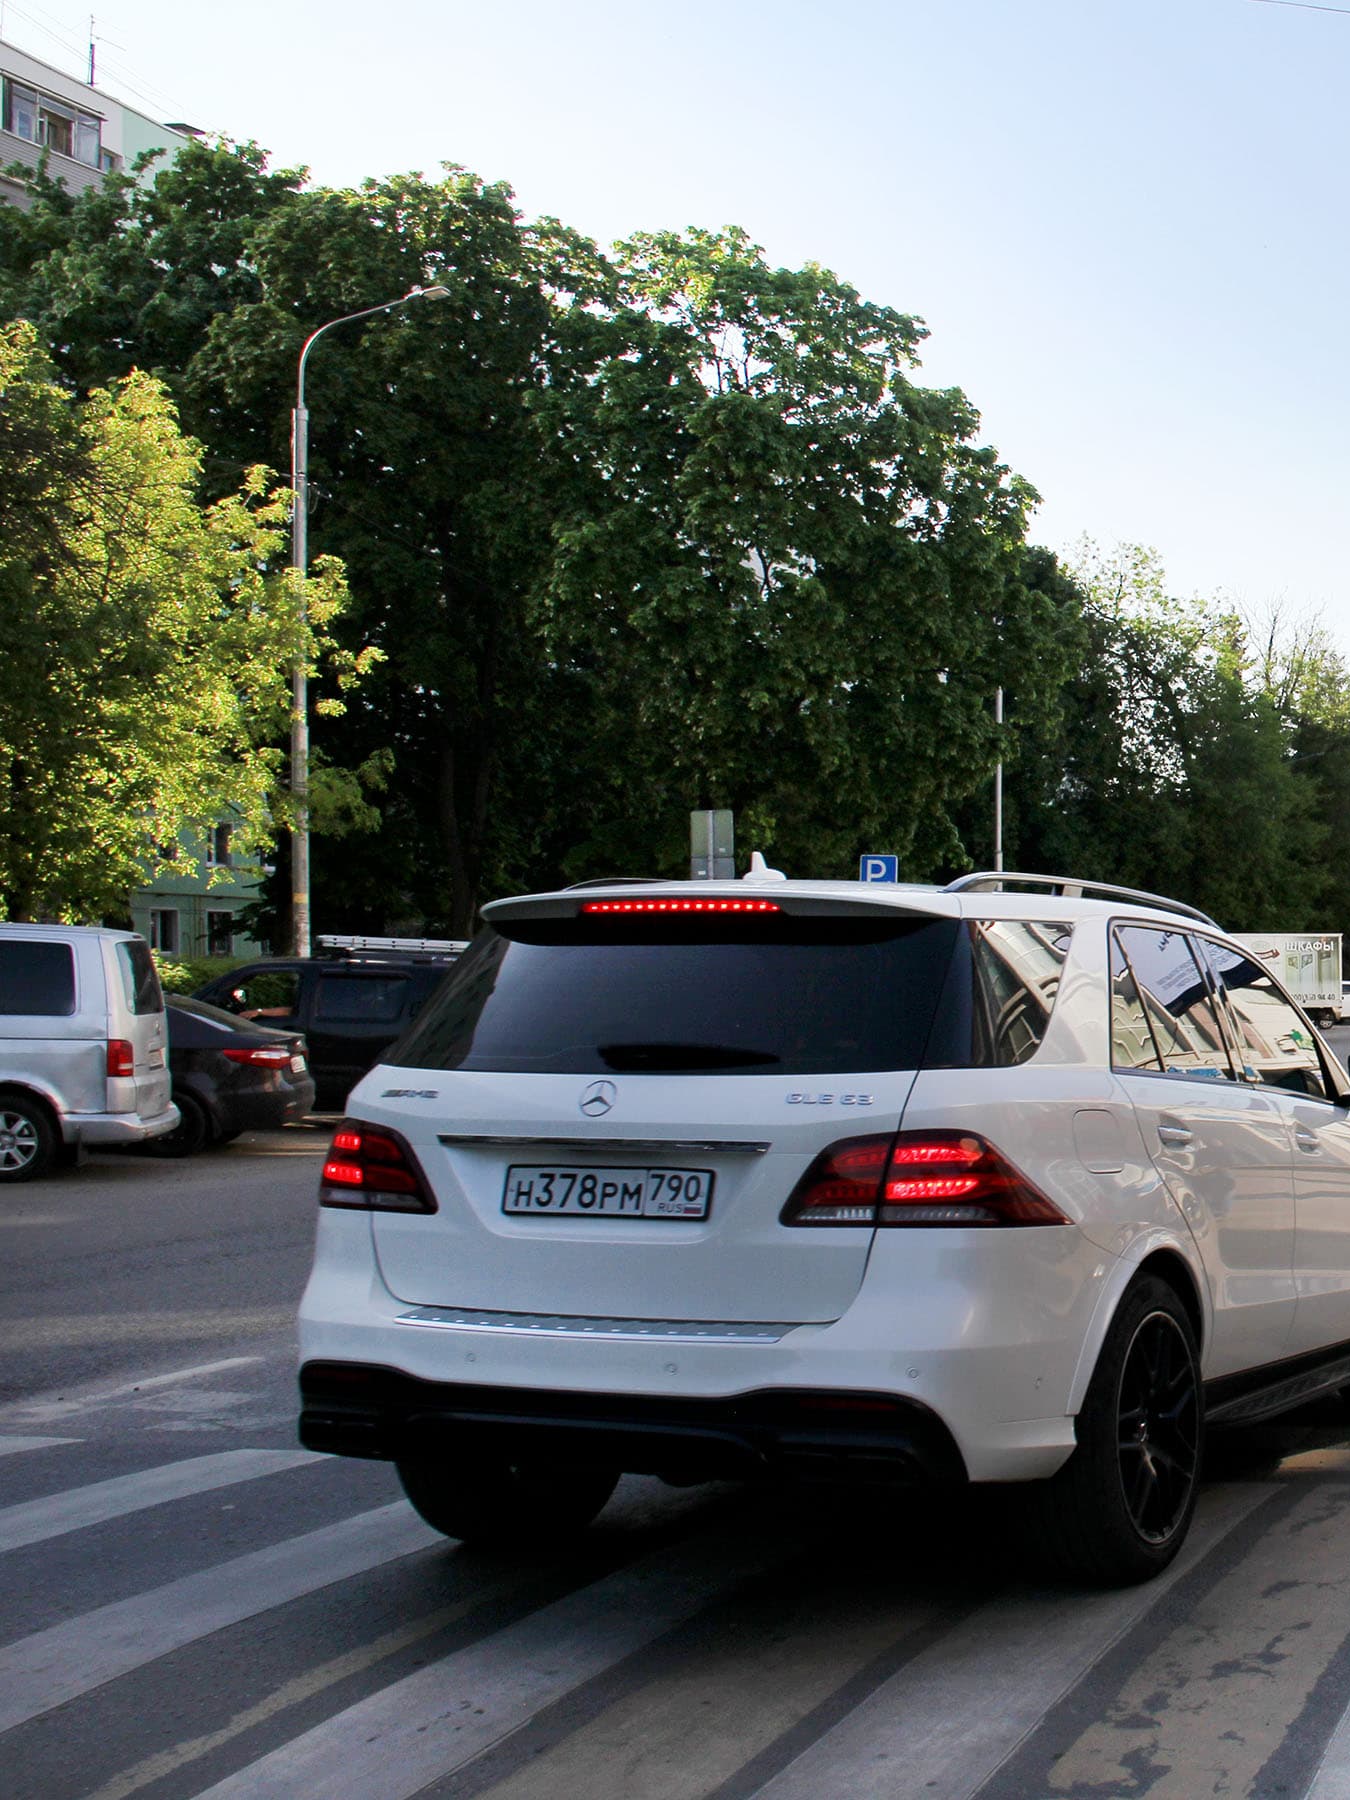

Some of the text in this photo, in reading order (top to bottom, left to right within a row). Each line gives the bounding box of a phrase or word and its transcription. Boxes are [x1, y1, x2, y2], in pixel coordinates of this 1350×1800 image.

[1285, 941, 1334, 951] ШКАФЫ
[785, 1093, 834, 1105] GLE
[514, 1173, 702, 1209] Н378РМ 790
[657, 1202, 683, 1214] RUS
